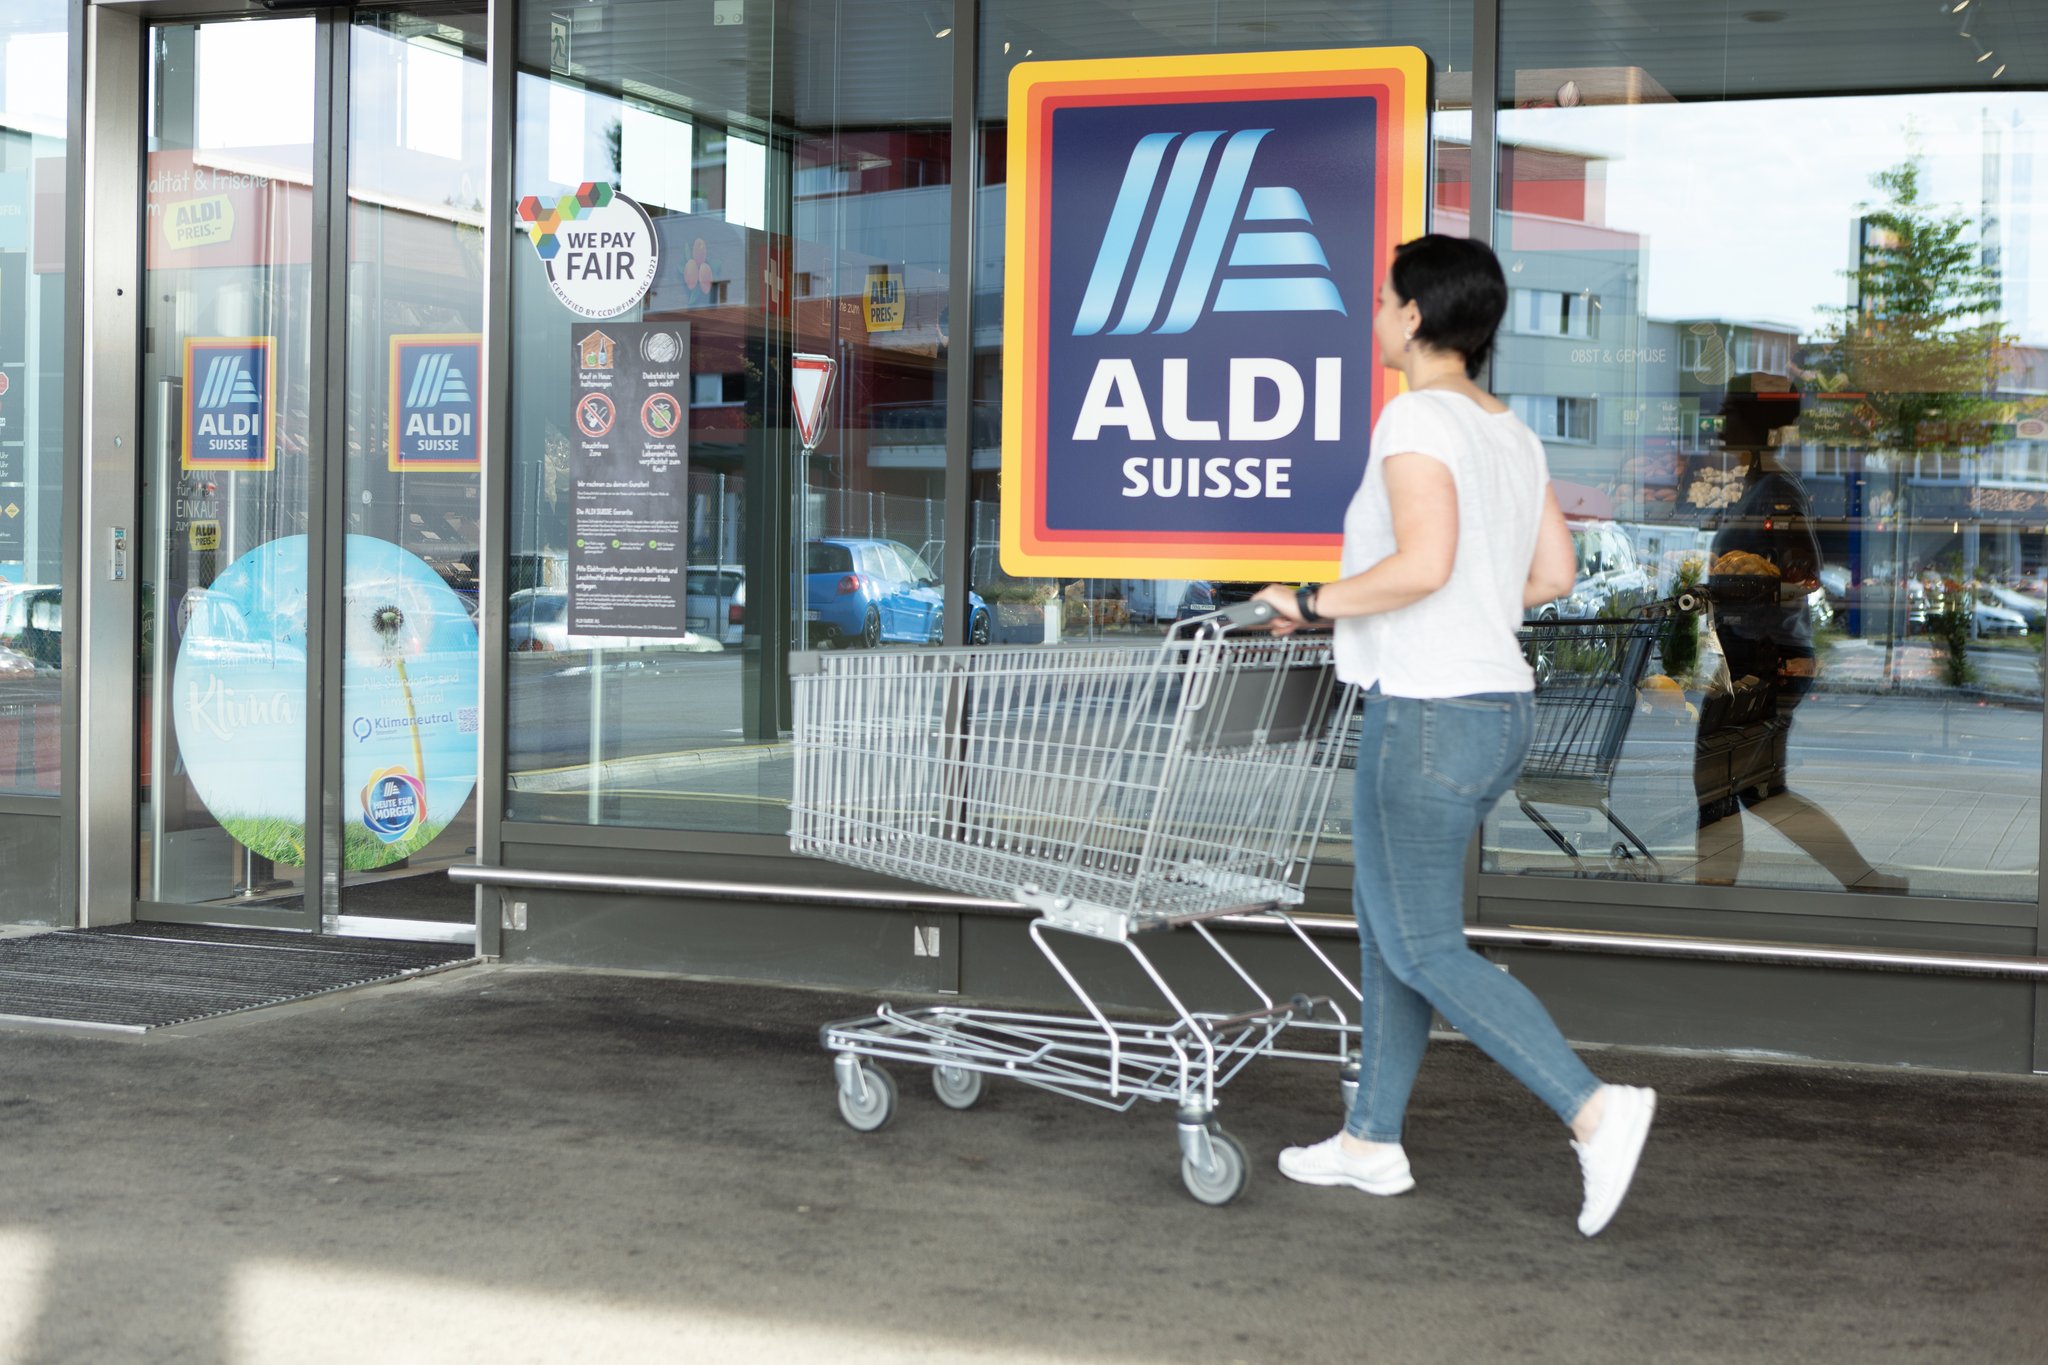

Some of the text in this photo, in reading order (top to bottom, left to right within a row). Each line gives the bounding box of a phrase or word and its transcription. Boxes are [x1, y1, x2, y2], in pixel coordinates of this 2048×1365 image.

[194, 169, 208, 191] &
[212, 168, 268, 190] Frische
[176, 200, 222, 227] ALDI
[567, 232, 636, 248] WE PAY
[567, 252, 635, 280] FAIR
[552, 282, 584, 313] CERTIFIED
[585, 308, 597, 317] BY
[647, 259, 657, 280] 2022
[870, 281, 898, 305] ALDI
[1571, 349, 1600, 363] OBST
[1603, 350, 1613, 363] &
[1072, 357, 1342, 441] ALDI
[198, 413, 259, 436] ALDI
[405, 413, 471, 436] ALDI
[209, 439, 248, 450] SUISSE
[417, 439, 459, 451] SUISSE
[1122, 457, 1291, 498] SUISSE
[177, 499, 219, 518] EINKAUF
[195, 523, 216, 537] ALDI
[184, 673, 298, 741] Klima
[375, 711, 454, 729] Klimaneutral
[375, 796, 413, 809] HEUTE FÜR
[375, 805, 415, 820] MORGEN
